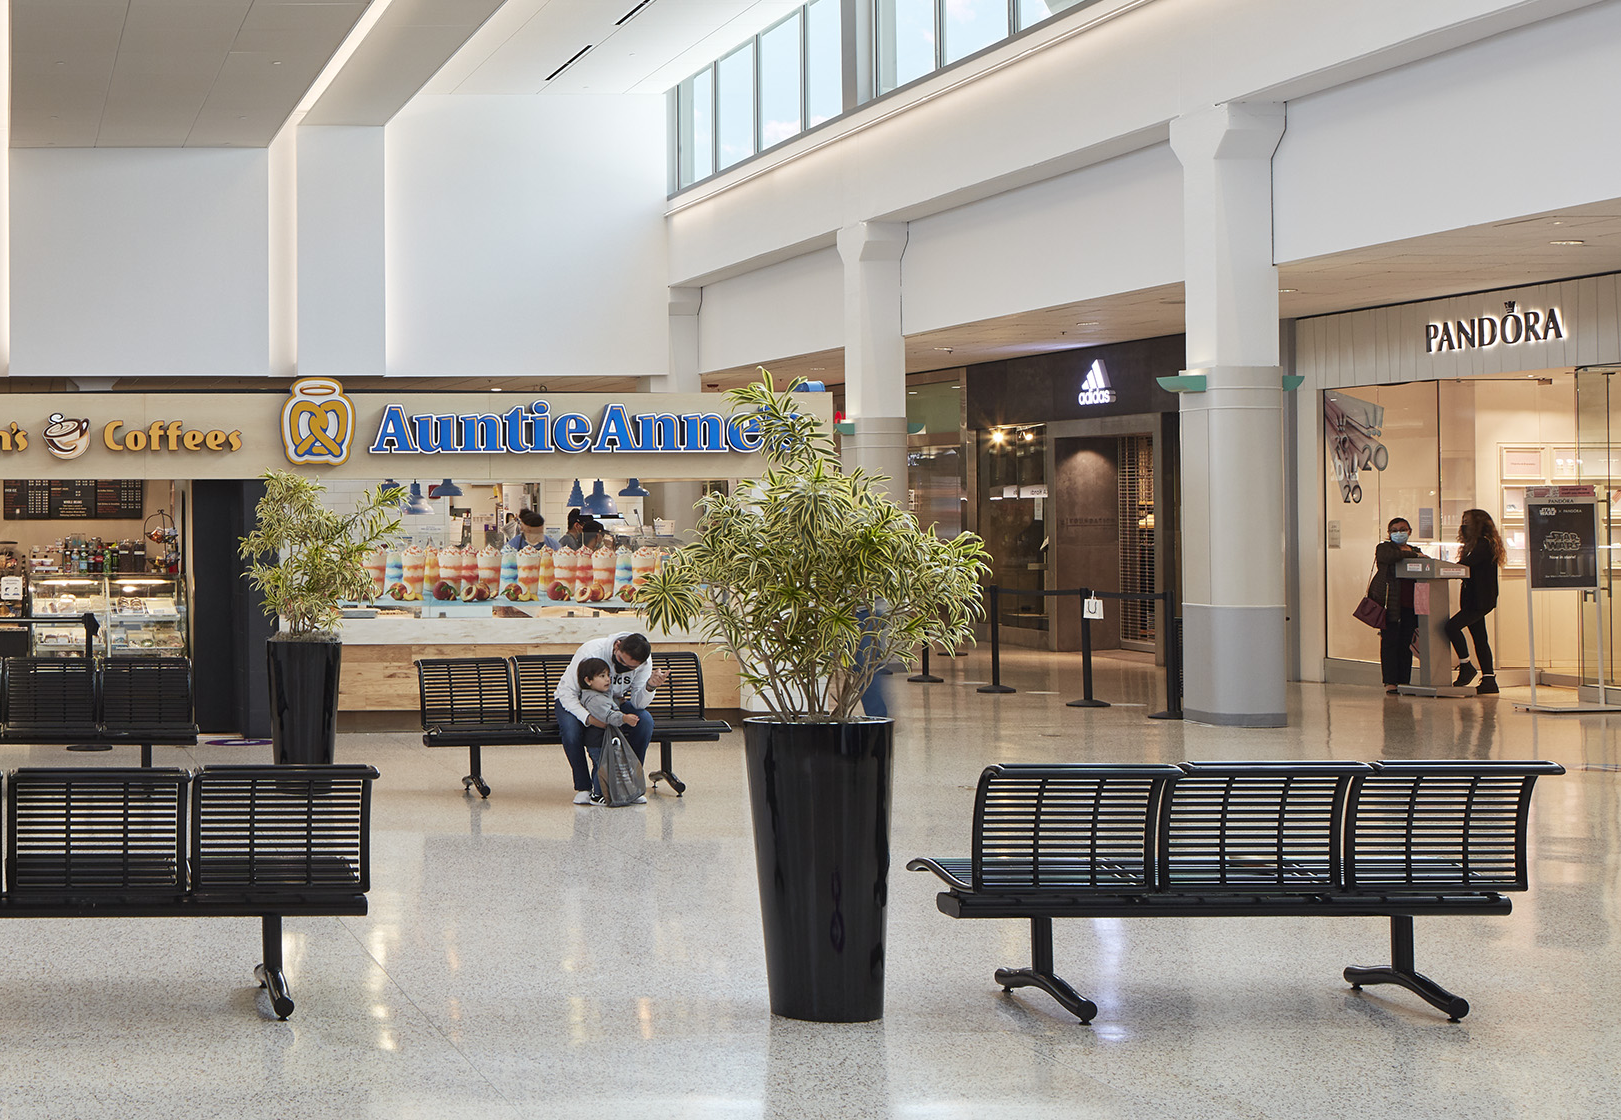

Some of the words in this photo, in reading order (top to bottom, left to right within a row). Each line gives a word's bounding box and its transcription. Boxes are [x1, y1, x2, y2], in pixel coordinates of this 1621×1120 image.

[1425, 302, 1563, 353] PANDORA
[1078, 389, 1111, 406] adidas
[103, 420, 243, 452] Coffees
[369, 399, 593, 454] Auntie
[591, 403, 808, 454] Anne
[1343, 484, 1363, 504] 20
[1544, 540, 1581, 551] WARS
[1545, 530, 1581, 541] STAR
